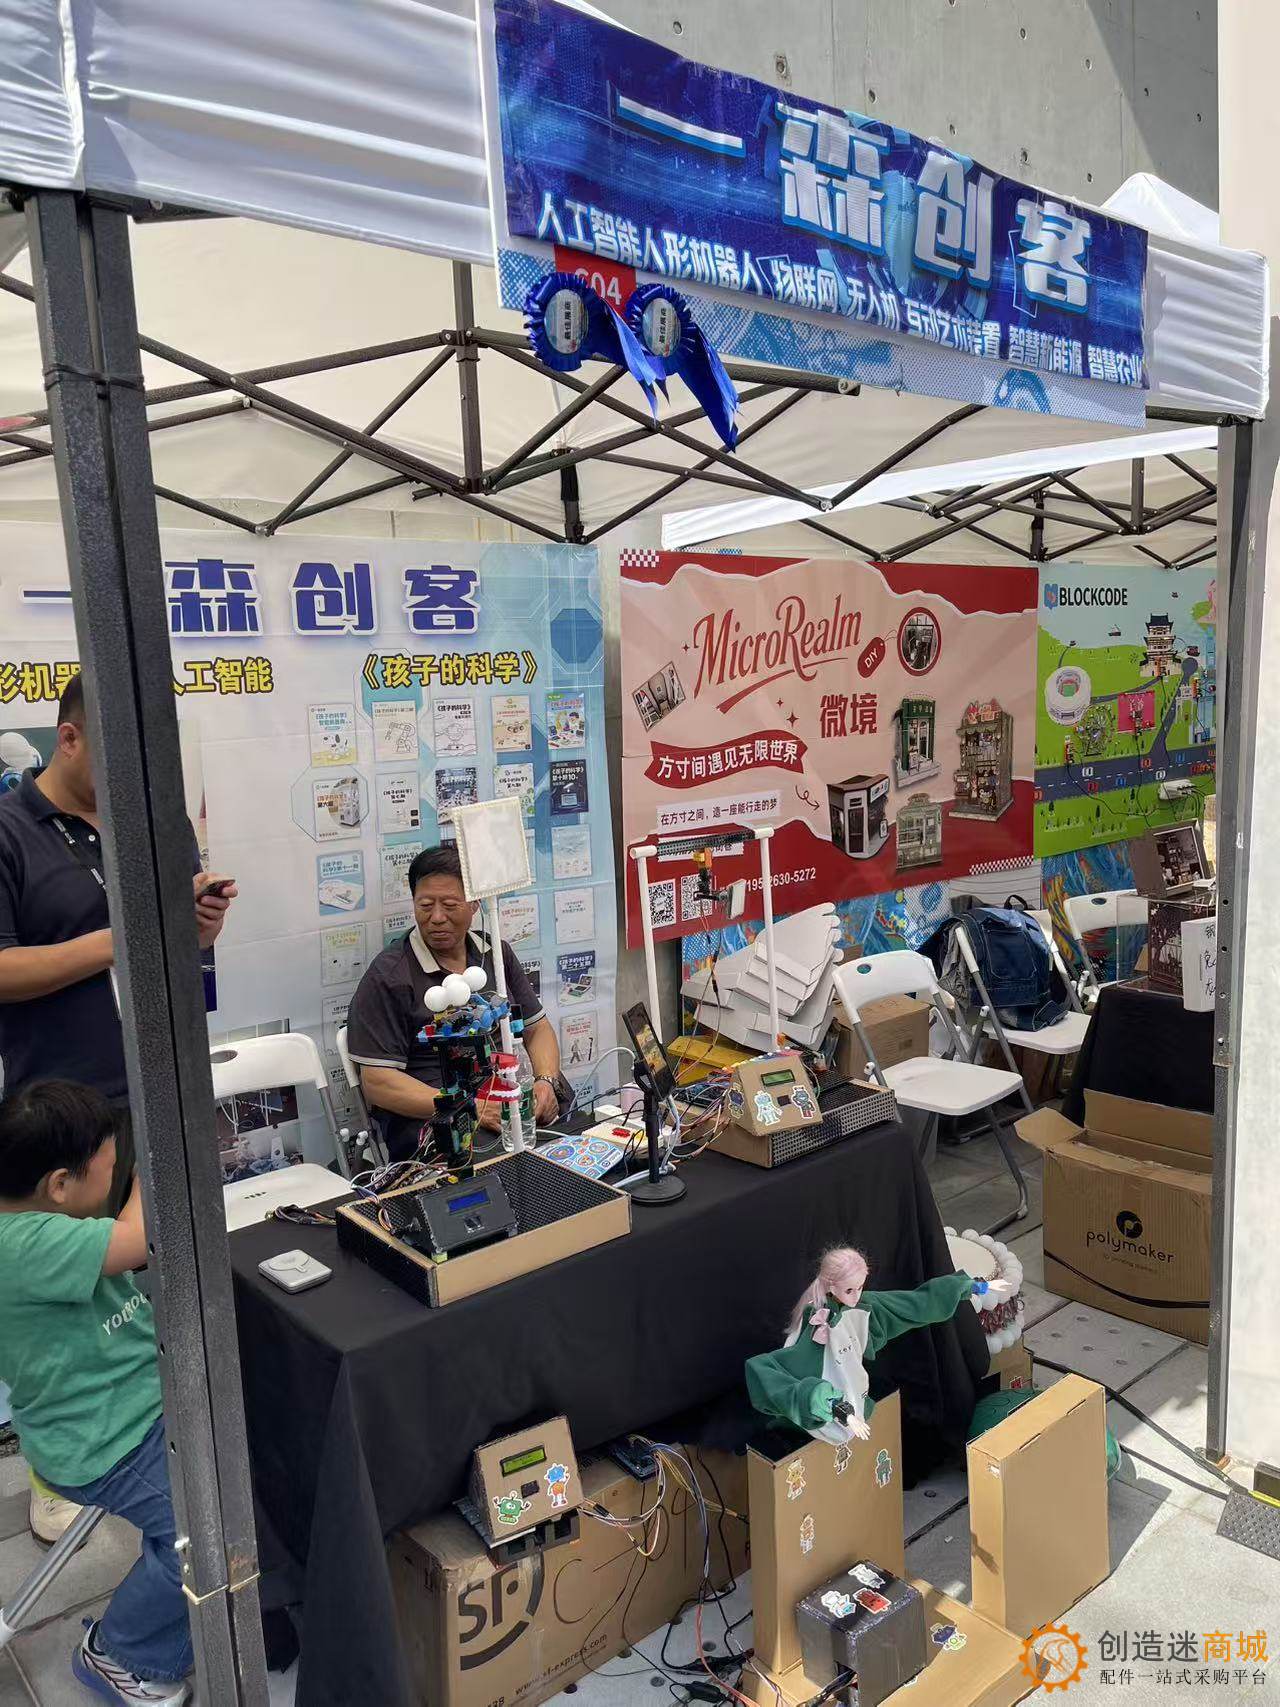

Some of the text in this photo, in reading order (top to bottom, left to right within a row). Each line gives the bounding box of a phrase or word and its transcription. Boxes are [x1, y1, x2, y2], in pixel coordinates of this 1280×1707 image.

[537, 190, 763, 296] 人工智能人形机器人
[769, 258, 838, 313] 物联网
[847, 276, 900, 331] 无人机
[904, 297, 1001, 359] 互动艺术装置
[1008, 325, 1083, 376] 智慧新能源
[1059, 587, 1128, 606] BLOCKCODE
[693, 594, 862, 699] MicroRealm
[864, 648, 880, 669] DIY
[173, 657, 273, 695] 工智能
[363, 650, 538, 689] 《孩子的科学》
[820, 692, 878, 738] 微境
[656, 739, 798, 780] 方寸间遇见无限世界
[1086, 1231, 1175, 1264] polymaker
